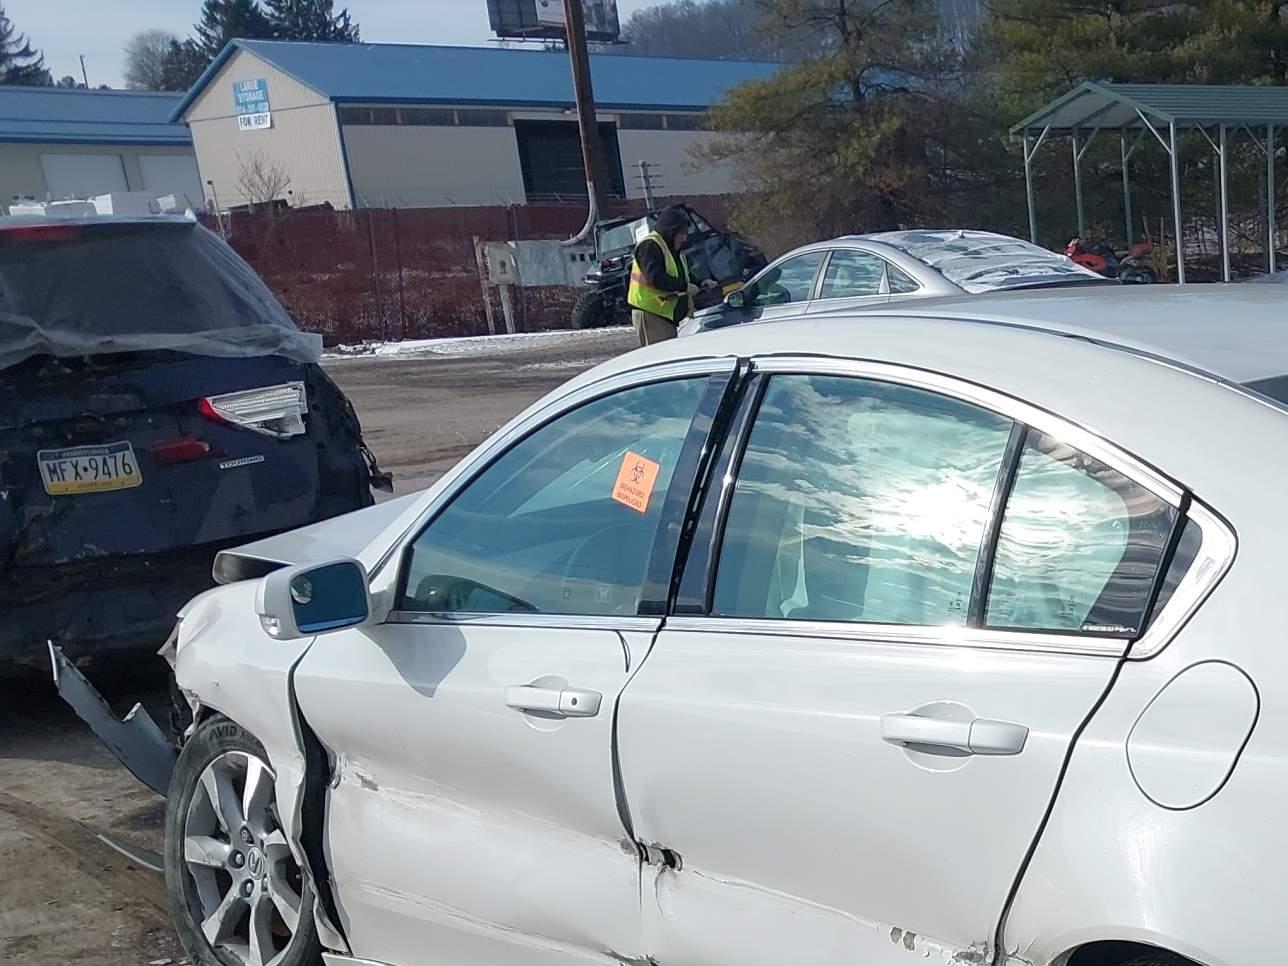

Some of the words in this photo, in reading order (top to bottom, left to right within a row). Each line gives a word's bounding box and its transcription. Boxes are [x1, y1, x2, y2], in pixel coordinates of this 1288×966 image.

[240, 116, 252, 127] FOR
[254, 114, 268, 125] RENT
[209, 725, 238, 741] AVID
